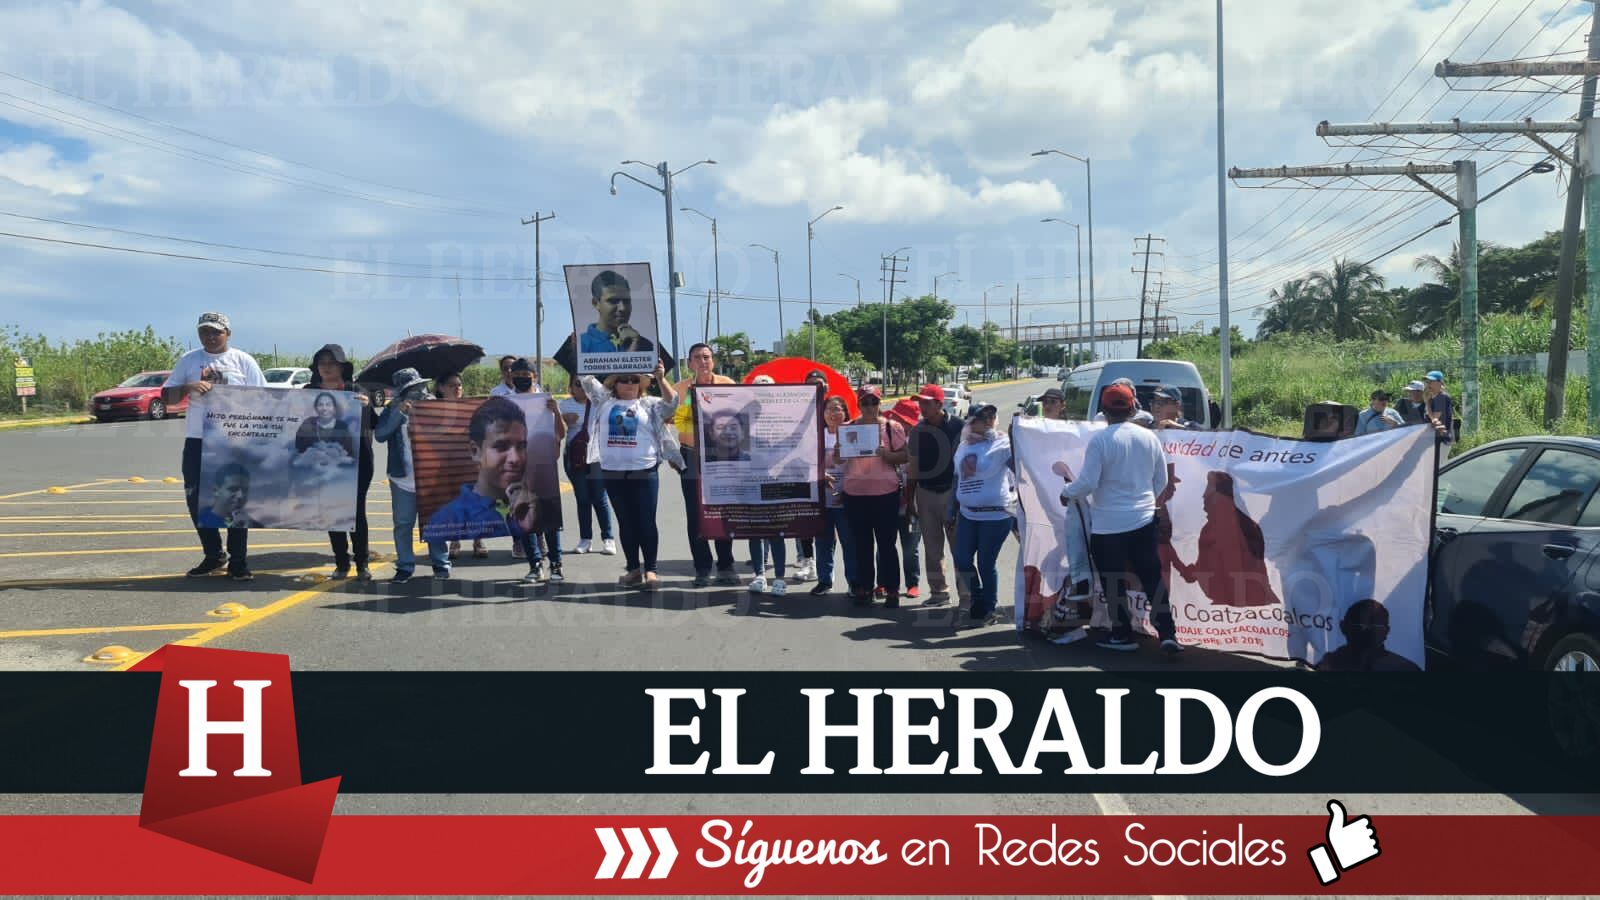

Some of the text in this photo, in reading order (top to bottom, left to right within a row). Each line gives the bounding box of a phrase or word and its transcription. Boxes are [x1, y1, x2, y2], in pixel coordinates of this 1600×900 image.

[1218, 440, 1244, 459] de
[1249, 449, 1318, 464] antes
[1184, 603, 1334, 632] Coatzacoalcos
[1206, 625, 1290, 638] COATZACOALCOS
